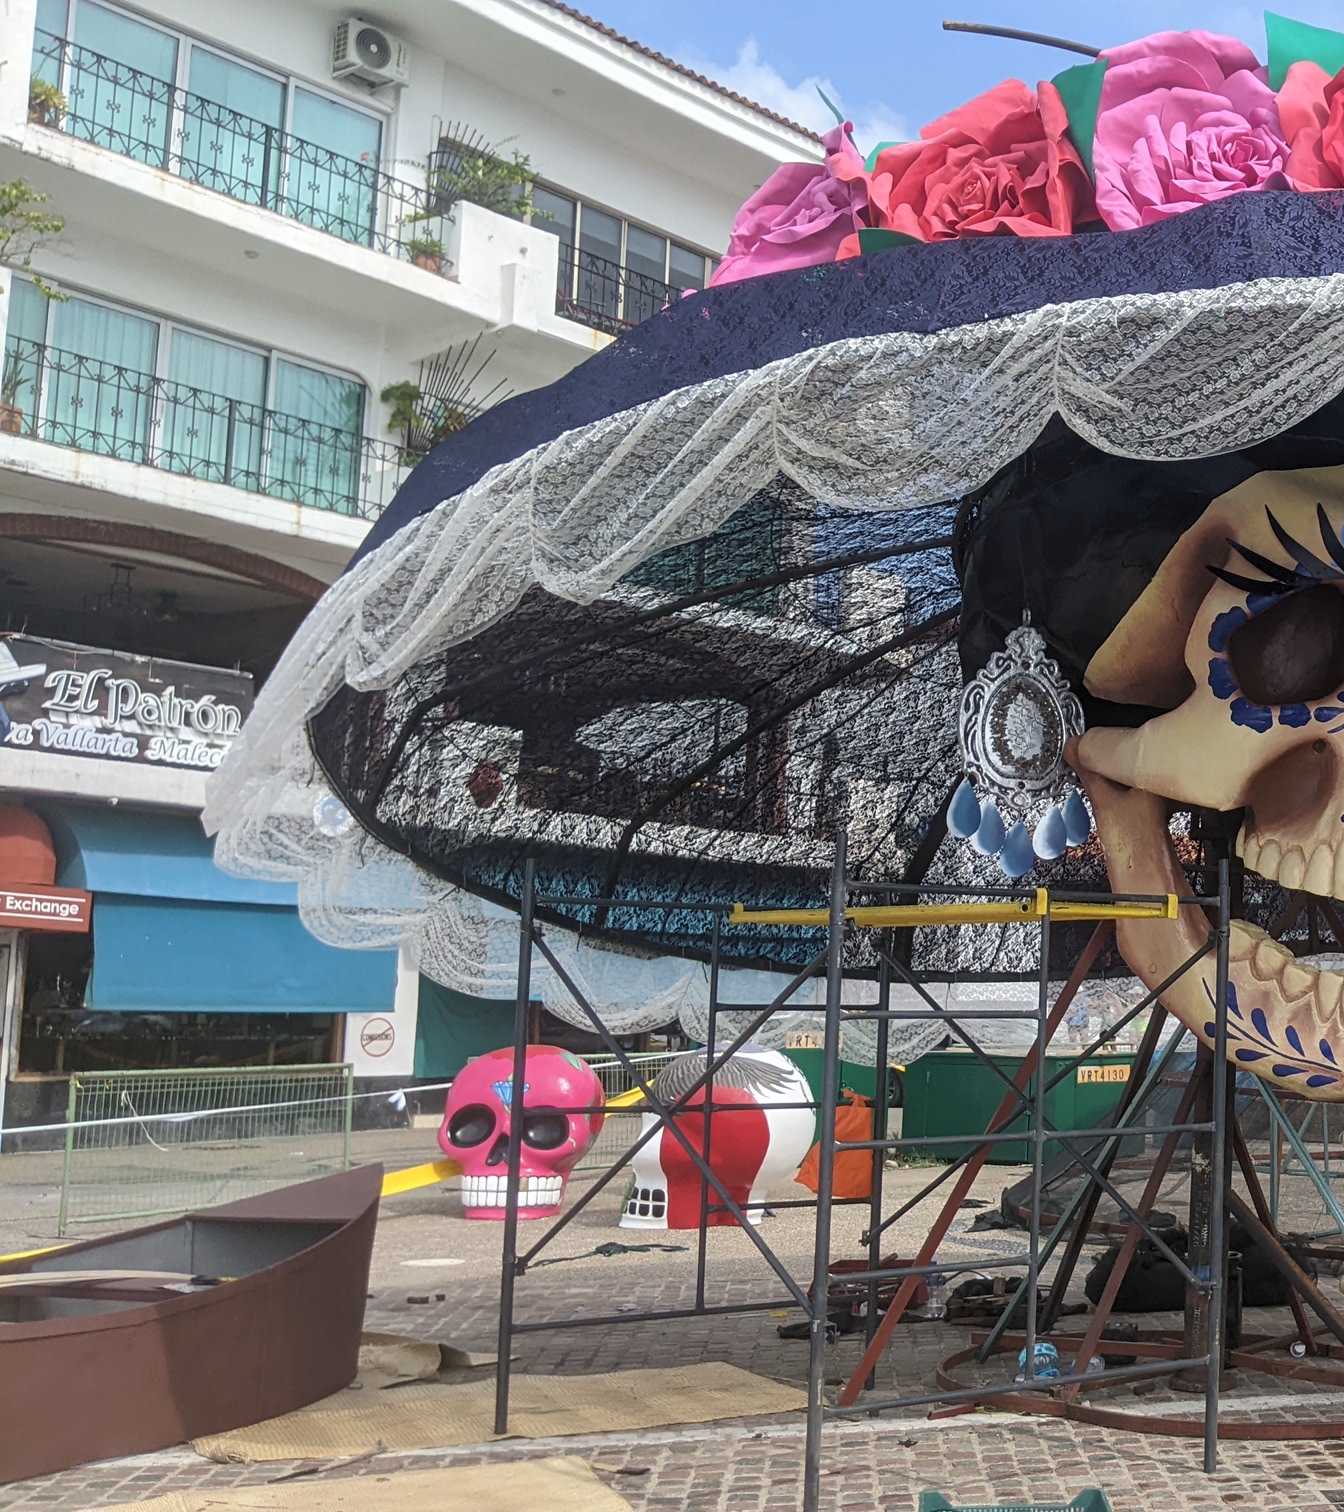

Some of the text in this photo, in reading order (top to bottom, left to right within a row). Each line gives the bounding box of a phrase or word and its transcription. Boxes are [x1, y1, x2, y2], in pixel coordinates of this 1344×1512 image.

[42, 668, 241, 736] El Patrón
[32, 718, 138, 757] Vallarta
[144, 736, 228, 768] Malec
[5, 896, 79, 917] Exchange
[1080, 1069, 1124, 1082] VRT4130
